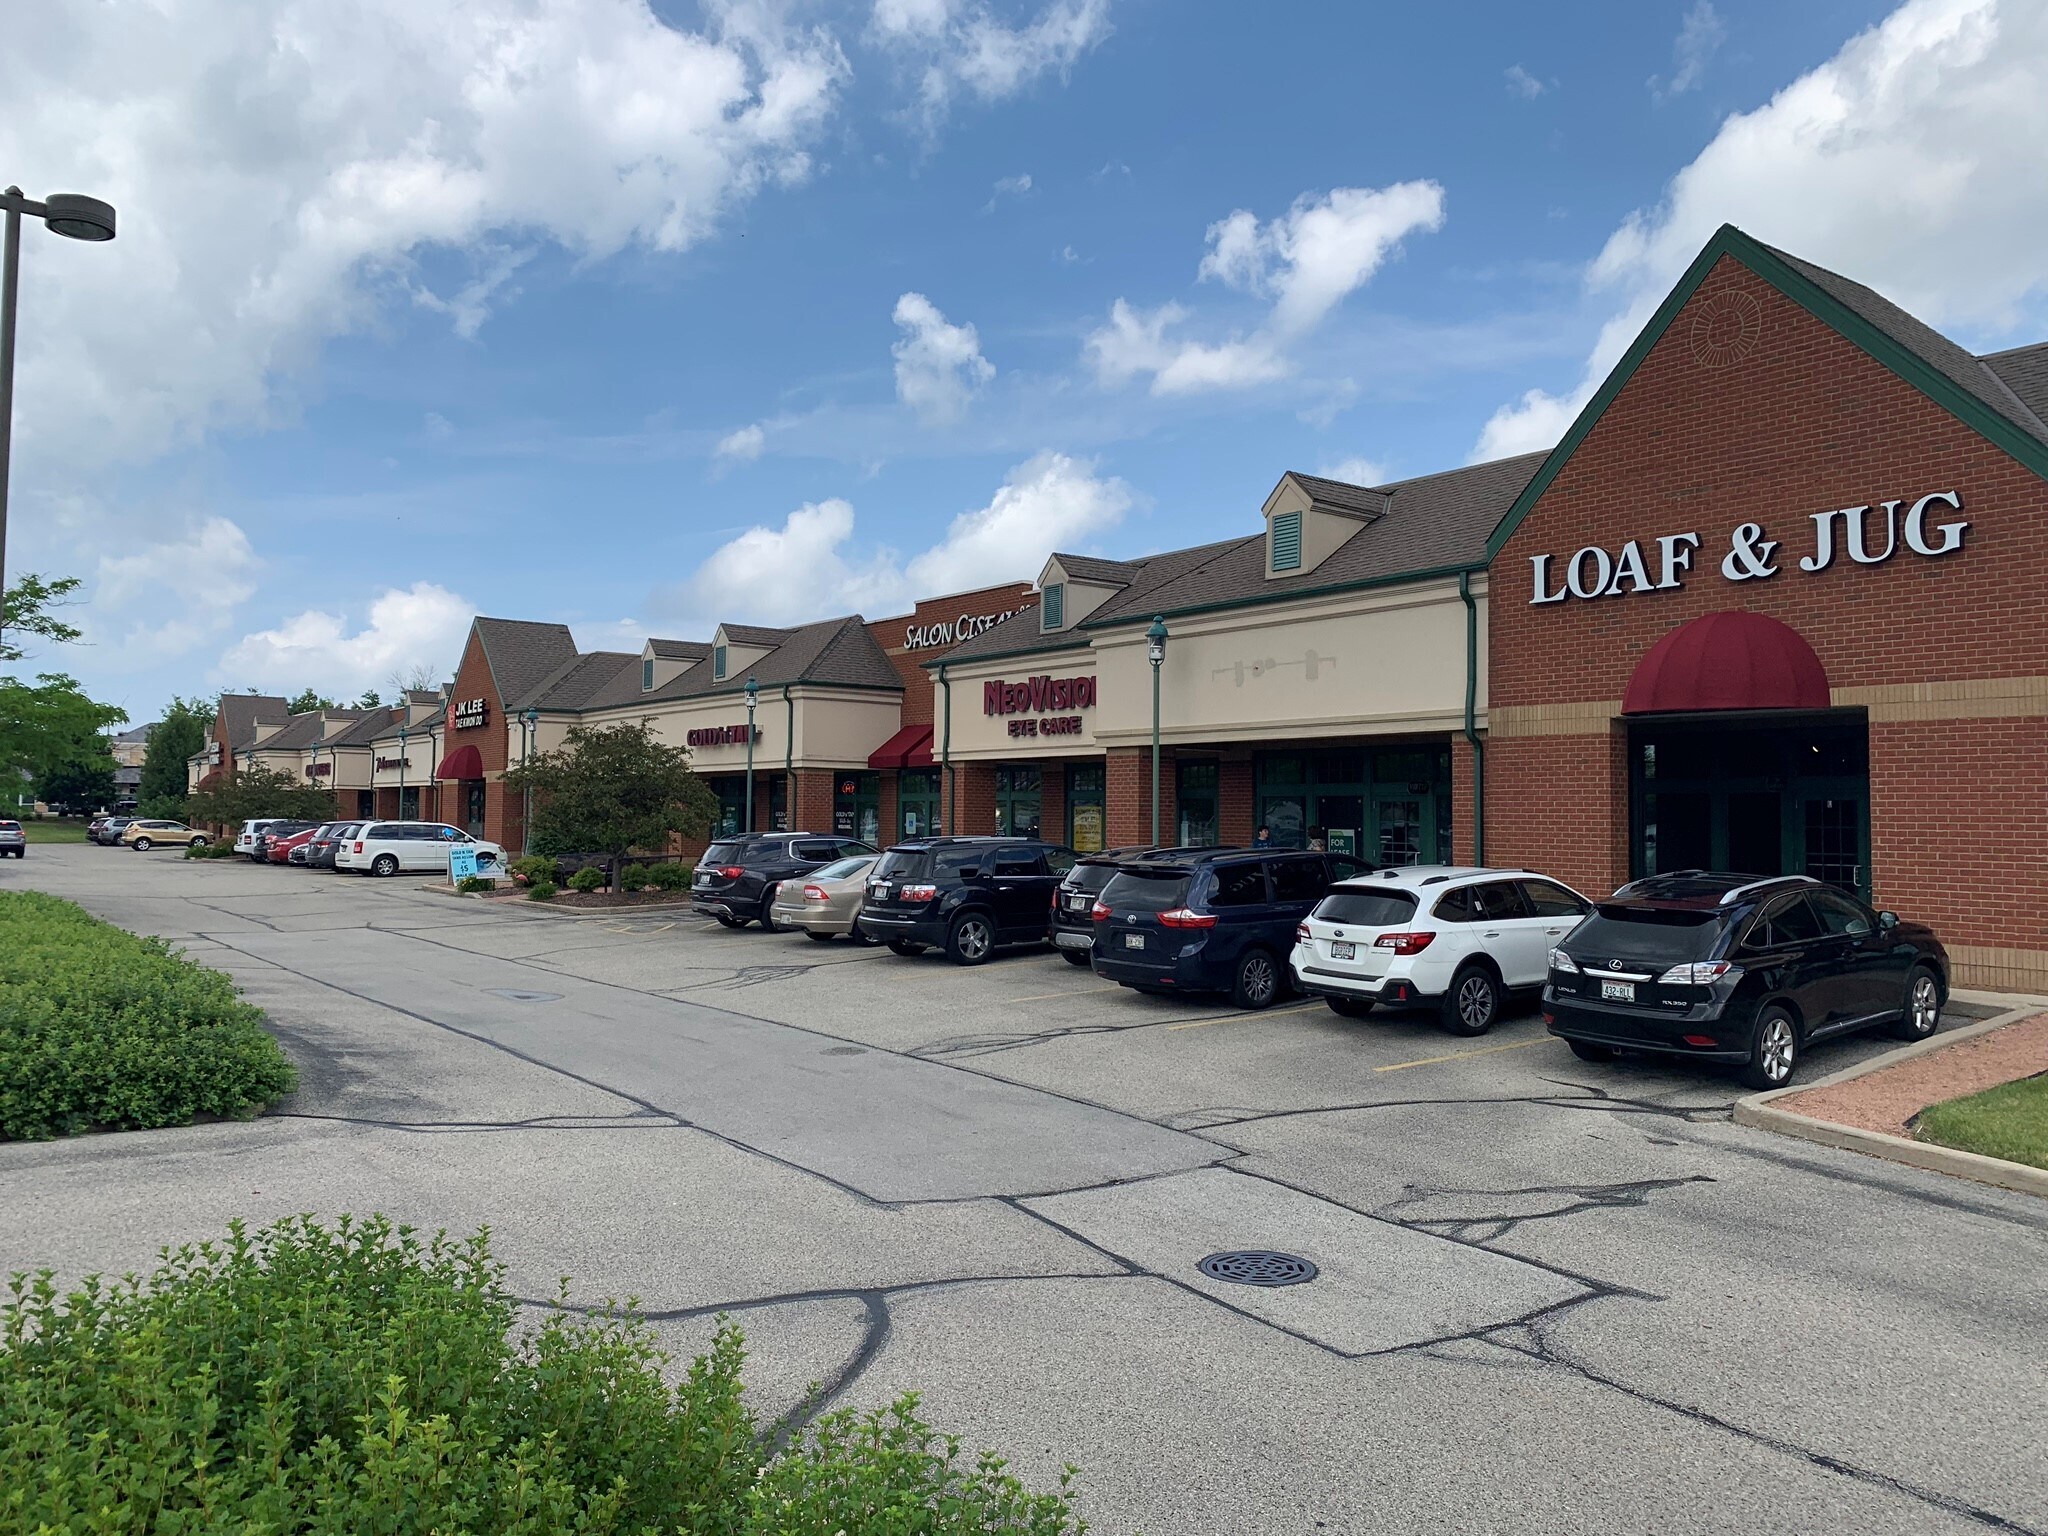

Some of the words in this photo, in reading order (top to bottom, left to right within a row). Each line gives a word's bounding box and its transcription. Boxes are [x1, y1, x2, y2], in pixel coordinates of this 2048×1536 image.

[1529, 531, 1700, 605] LOAF
[1721, 522, 1780, 581] &
[1800, 490, 1968, 572] JUG
[903, 622, 953, 649] SALON
[456, 702, 466, 716] JK
[467, 699, 483, 714] LEE
[1008, 719, 1037, 737] EYE
[1039, 716, 1082, 736] CARE
[1330, 838, 1345, 847] FOR
